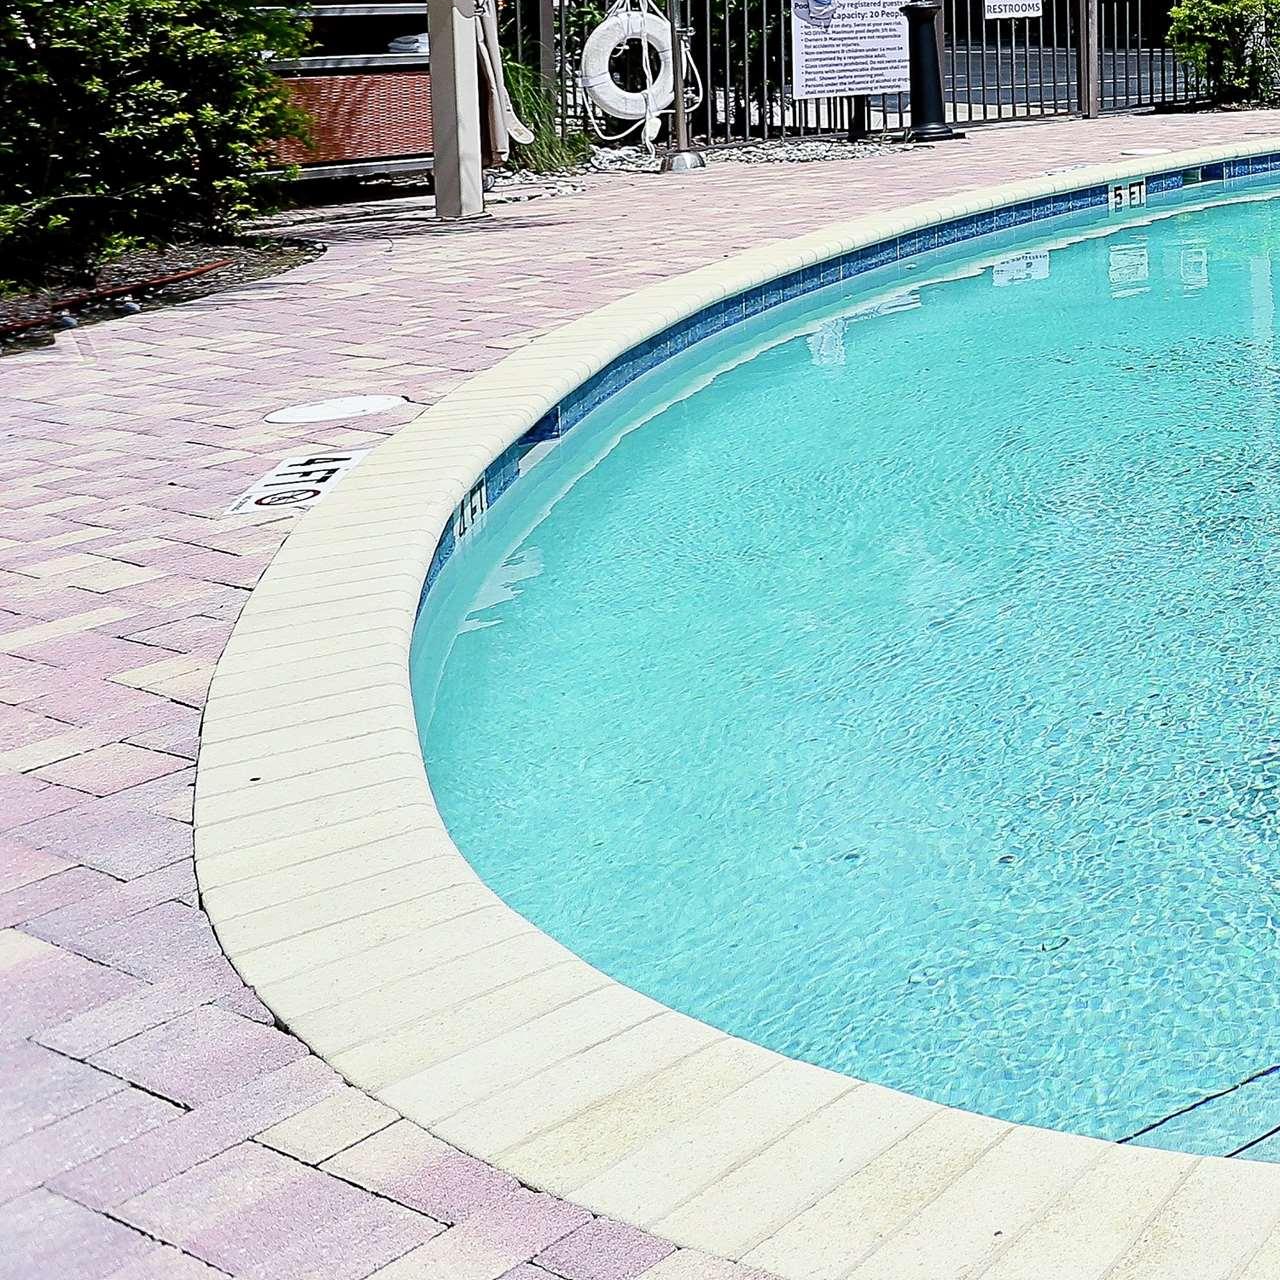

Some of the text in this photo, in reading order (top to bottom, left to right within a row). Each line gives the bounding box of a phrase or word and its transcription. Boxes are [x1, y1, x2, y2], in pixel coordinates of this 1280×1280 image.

[869, 11, 880, 19] 20
[987, 3, 1040, 14] RESTROOMS
[1114, 186, 1123, 206] 5
[263, 457, 352, 488] 4 FT
[469, 477, 485, 525] FT
